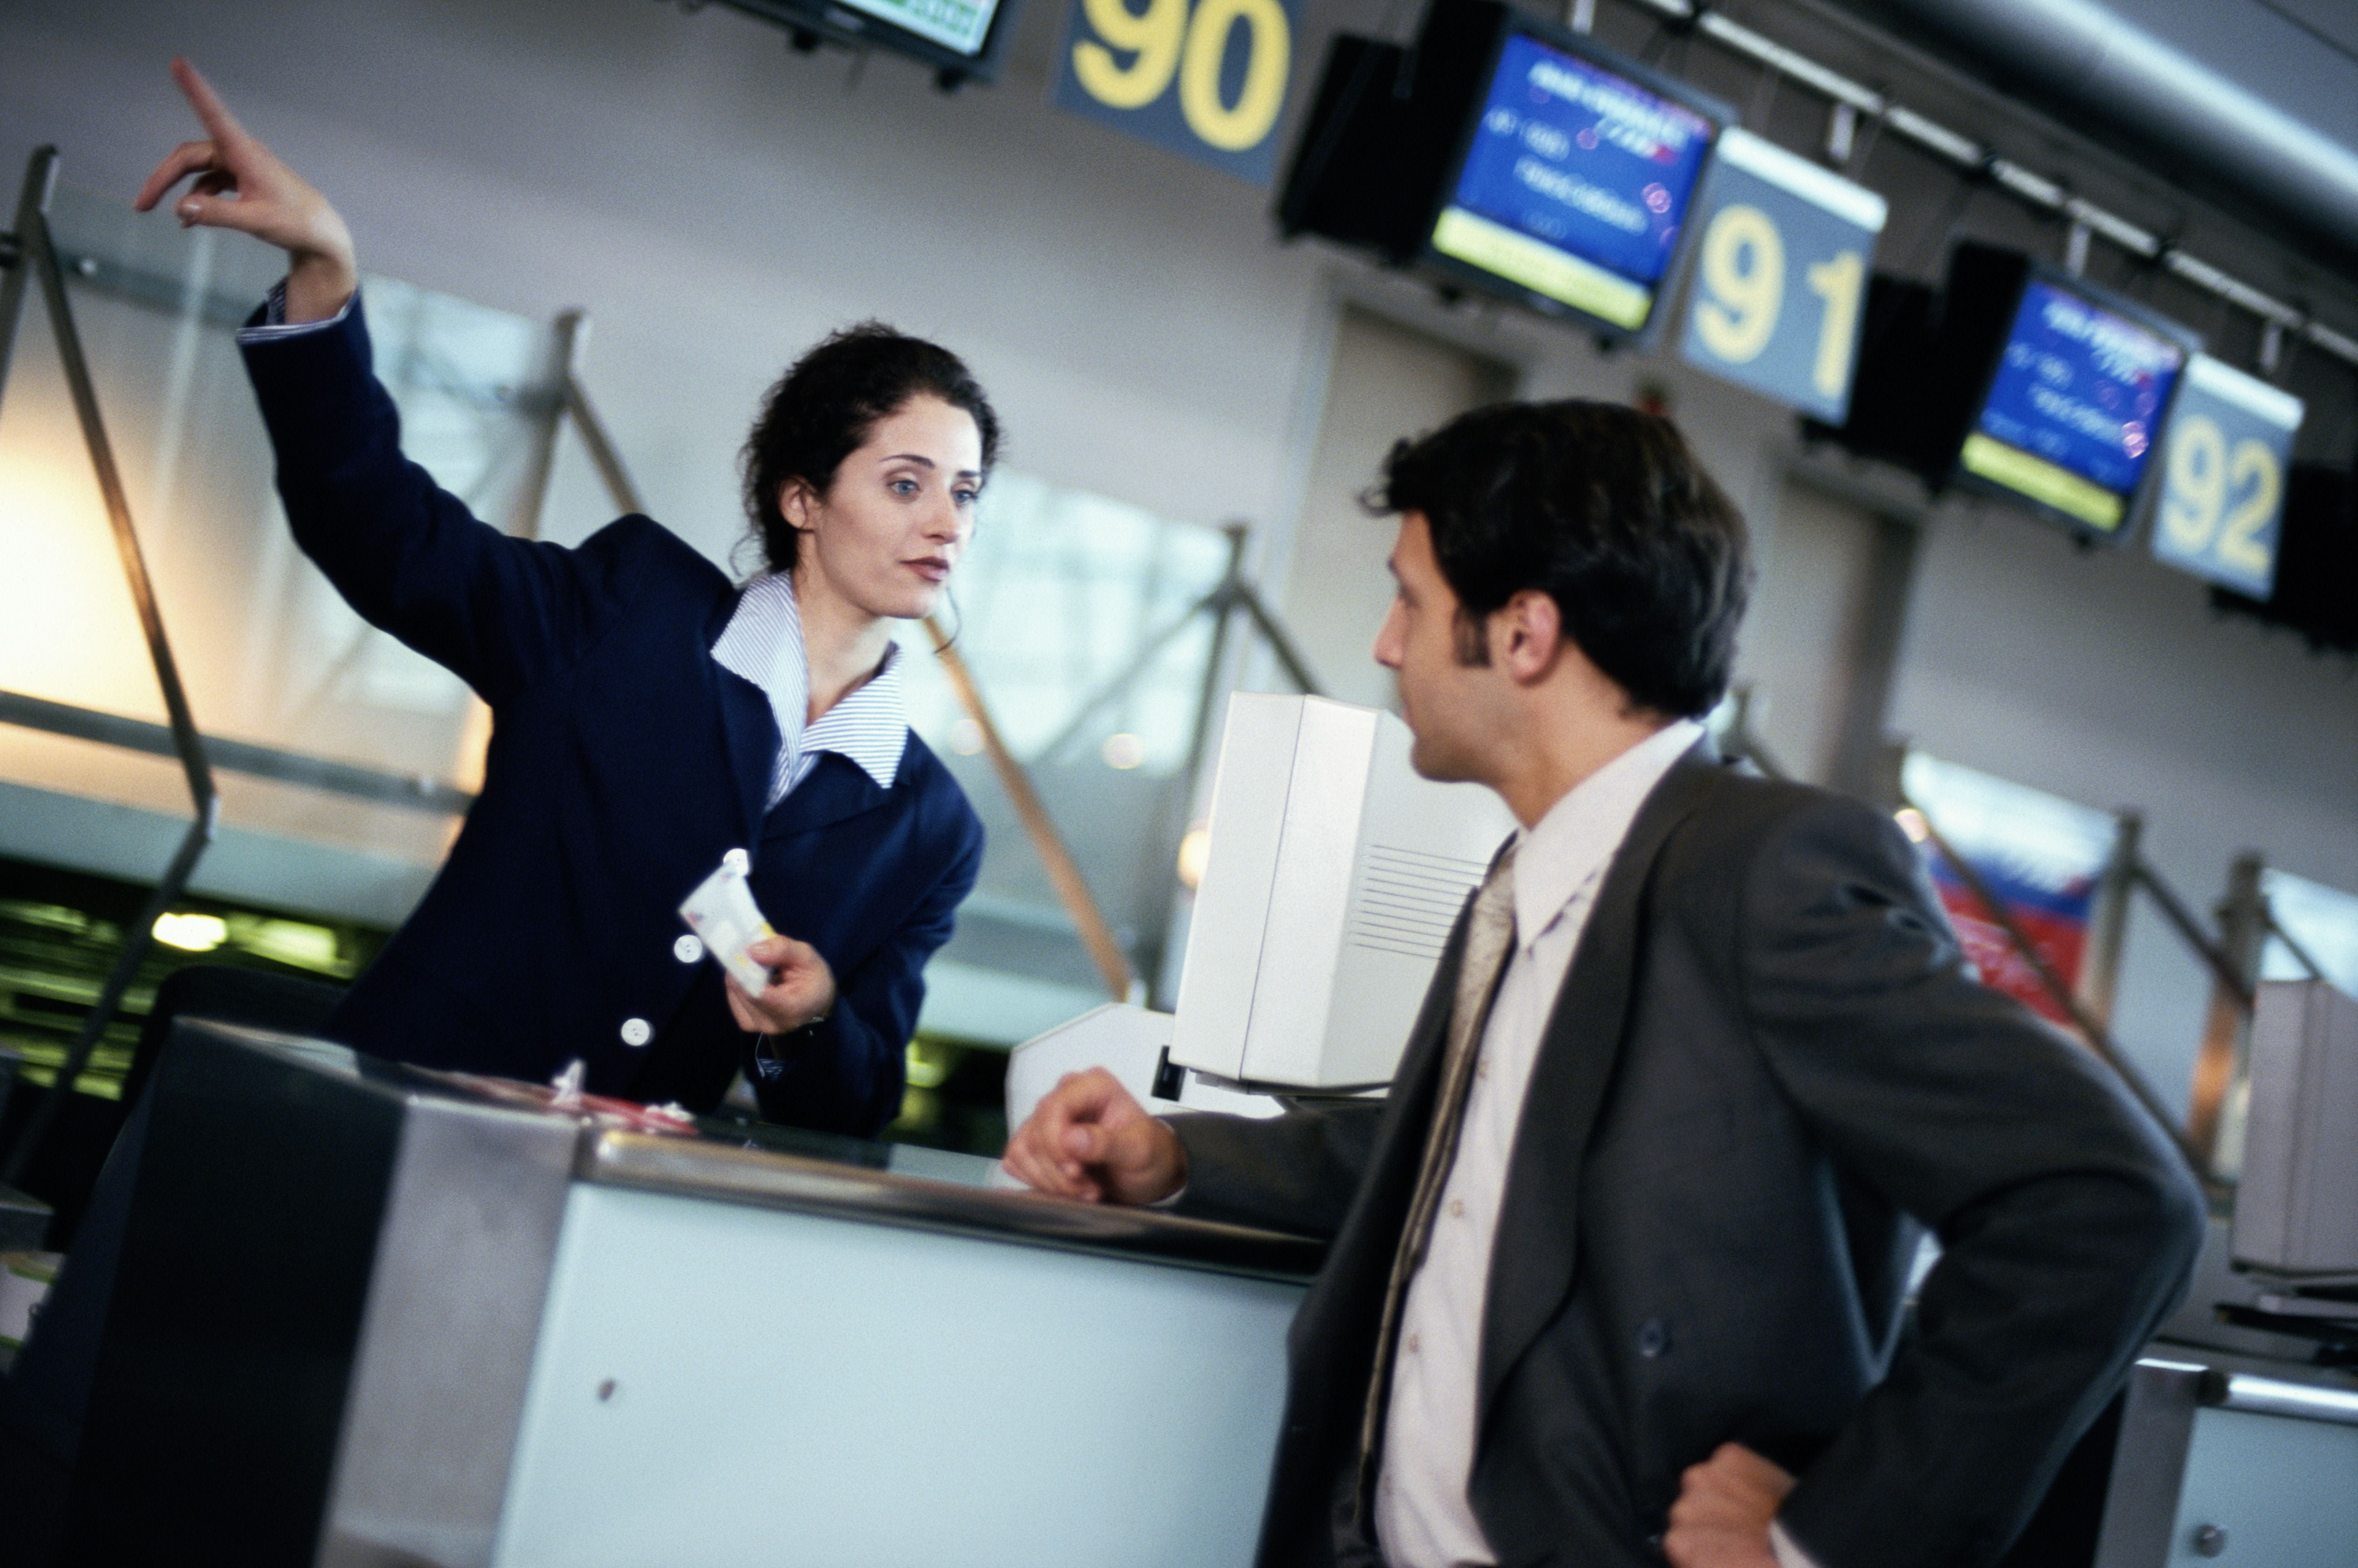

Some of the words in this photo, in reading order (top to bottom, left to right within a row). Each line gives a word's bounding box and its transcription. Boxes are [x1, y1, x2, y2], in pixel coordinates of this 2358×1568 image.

[1073, 0, 1292, 151] 90
[1694, 204, 1863, 398] 91
[2164, 414, 2281, 577] 92
